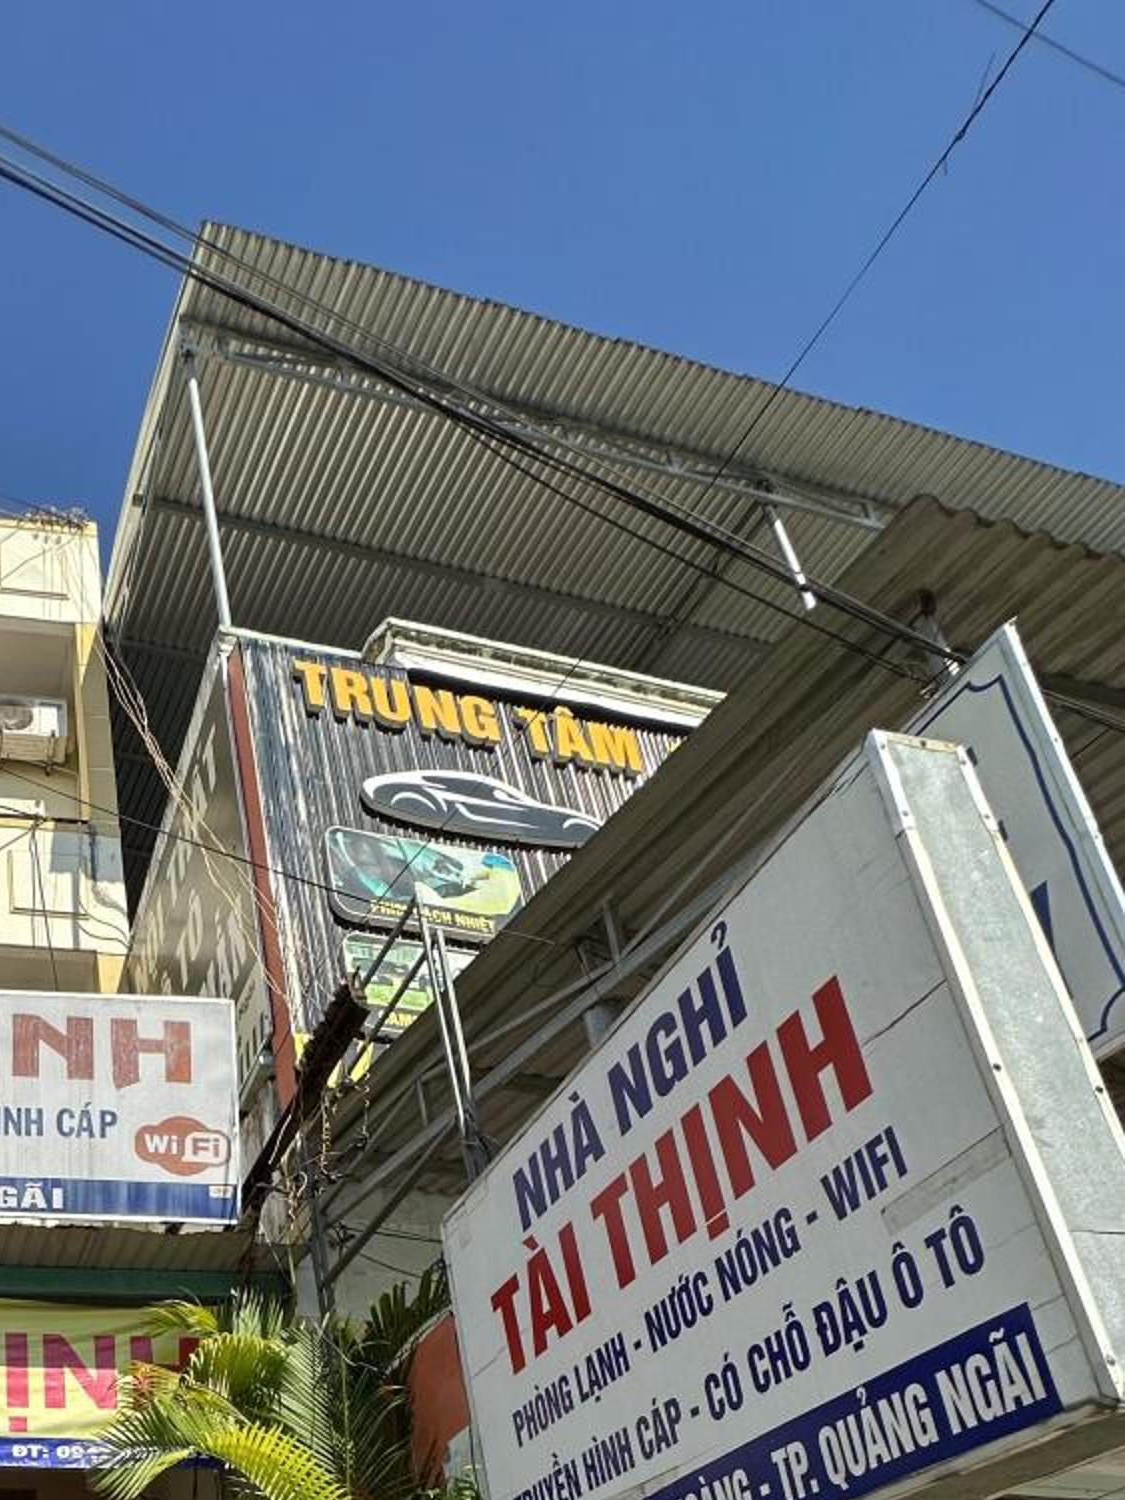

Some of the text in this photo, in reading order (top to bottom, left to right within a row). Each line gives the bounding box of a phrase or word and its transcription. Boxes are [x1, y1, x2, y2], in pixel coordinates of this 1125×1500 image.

[291, 660, 643, 778] TRUNG TÂM
[56, 1100, 118, 1139] CÁP
[491, 975, 873, 1375] TÀI THỊNH
[512, 921, 747, 1232] NHÀ NGHỈ
[512, 1375, 574, 1448] PHÒNG
[574, 1332, 630, 1403] LẠNH
[644, 1271, 714, 1353] NƯỚC
[715, 1207, 801, 1303] NÓNG
[820, 1125, 907, 1221] WIFI
[581, 1427, 636, 1491] HÌNH
[635, 1397, 682, 1461] CÁP
[704, 1352, 744, 1421] CÓ
[747, 1302, 812, 1394] CHỖ
[812, 1269, 888, 1358] ĐẬU
[891, 1240, 925, 1309] Ô
[924, 1204, 986, 1289] TÔ
[12, 1444, 50, 1459] ĐT:
[818, 1386, 940, 1491] QUẢNG
[934, 1327, 1048, 1436] NGÃI
